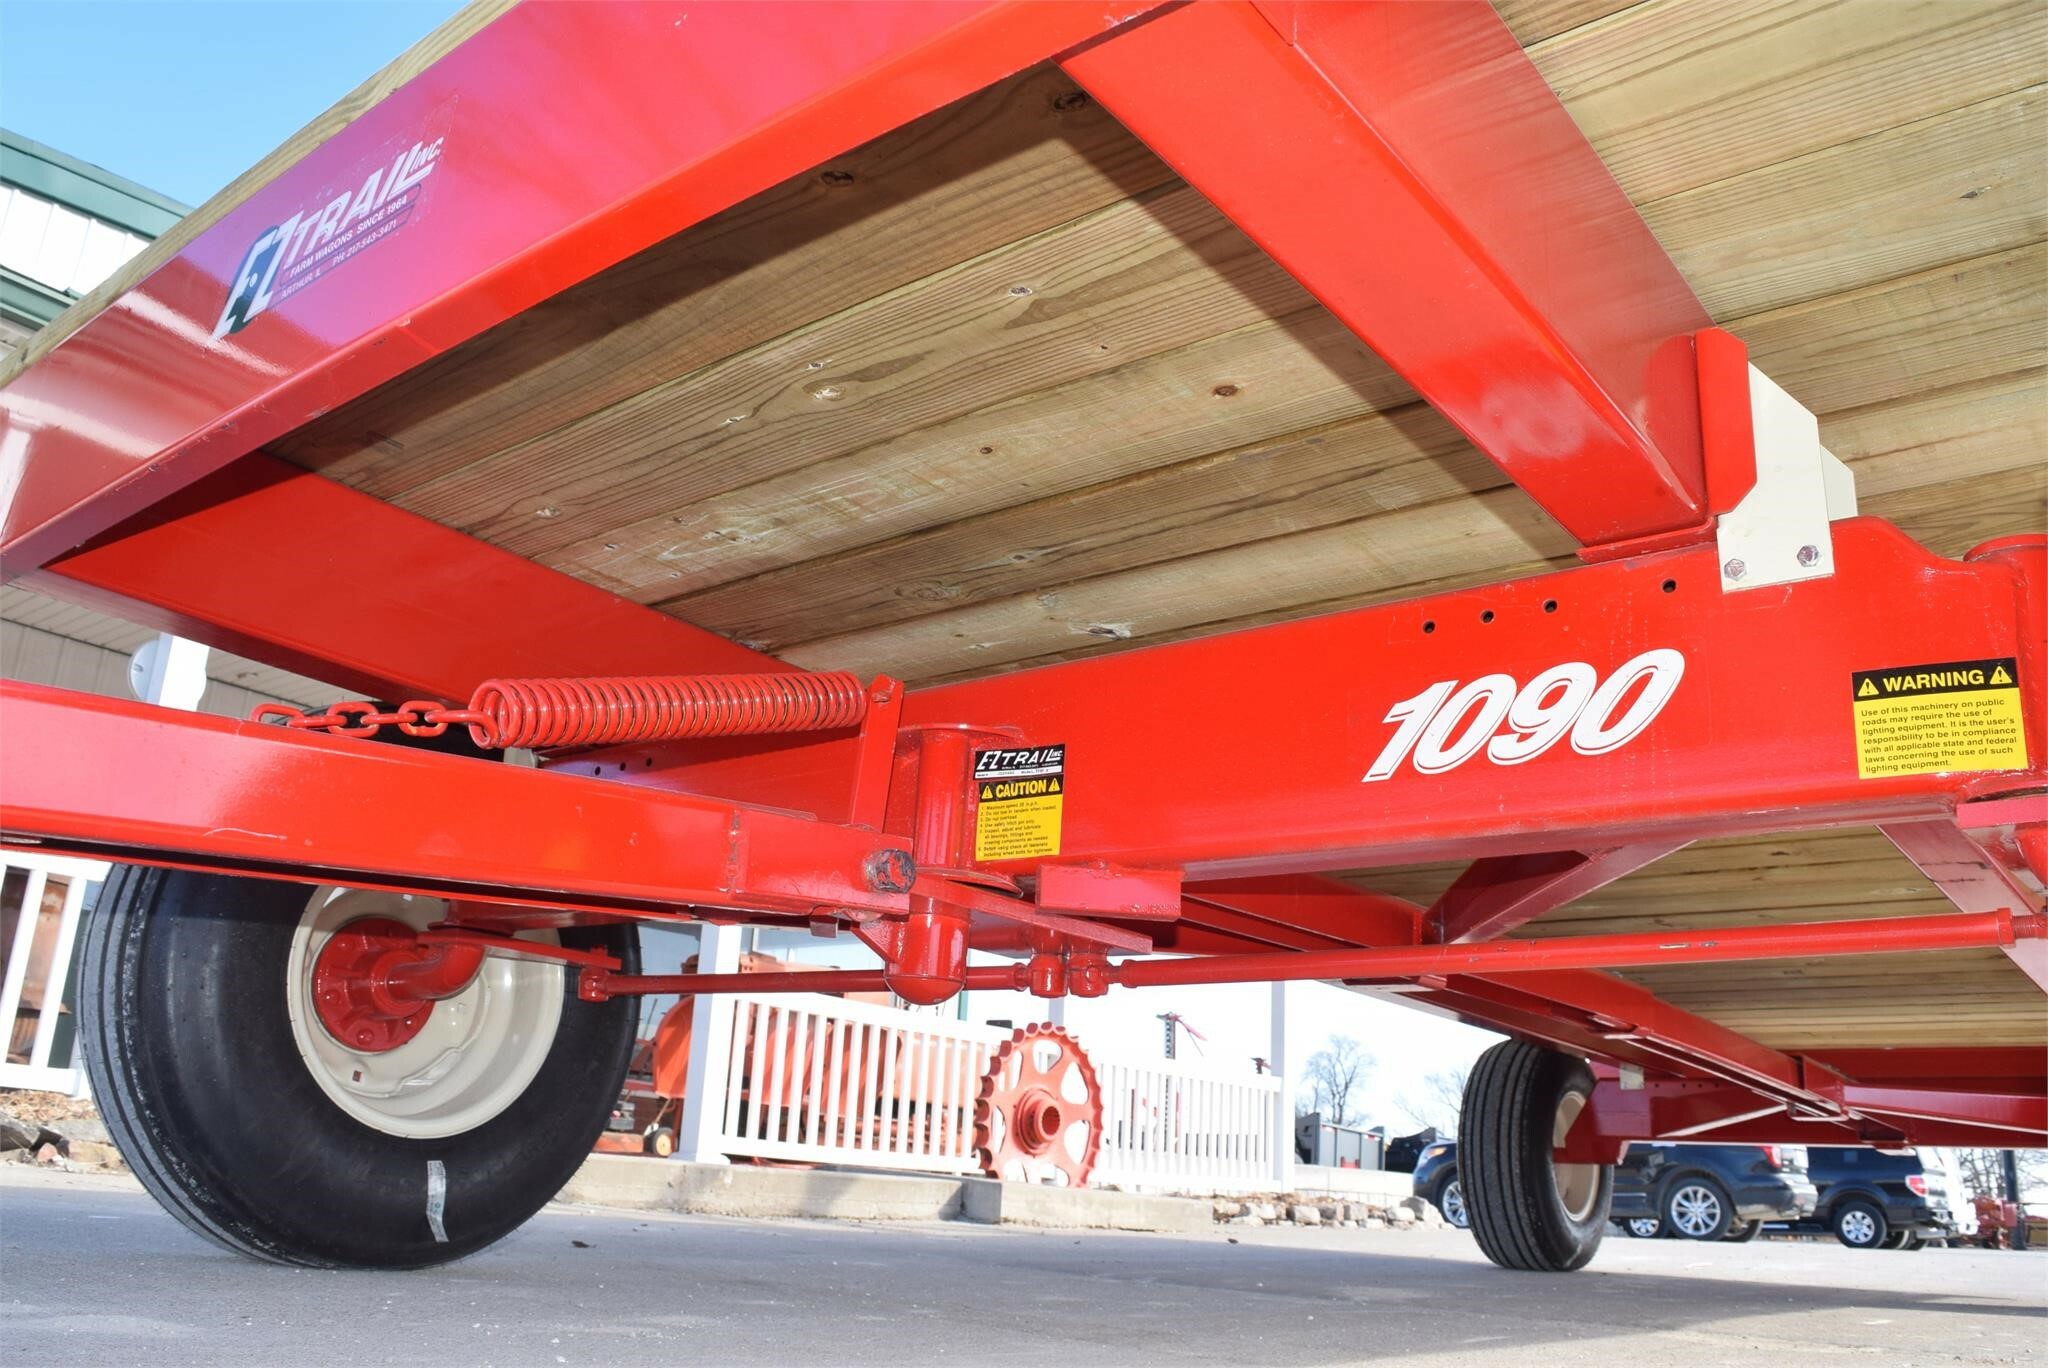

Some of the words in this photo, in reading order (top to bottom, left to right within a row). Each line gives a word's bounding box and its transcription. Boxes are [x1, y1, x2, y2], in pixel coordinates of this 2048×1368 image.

[289, 255, 314, 278] FARM
[315, 230, 353, 261] WAGONS
[356, 208, 386, 235] SINCE
[386, 194, 408, 214] 1964
[1883, 669, 1985, 692] WARNING
[1360, 648, 1686, 783] 1090
[1861, 709, 1878, 717] Use
[1891, 706, 1909, 714] this
[1911, 703, 1958, 712] machinery
[1975, 698, 2005, 709] public
[1862, 718, 1887, 726] roads
[1889, 716, 1909, 724] may
[1911, 713, 1943, 722] require
[1946, 710, 1961, 718] the
[1963, 710, 1980, 718] use
[1983, 708, 1992, 716] of
[1863, 726, 1895, 736] lighting
[1897, 722, 1948, 732] equipment.
[1986, 717, 2015, 725] user's
[1864, 733, 1923, 744] responsibility
[1962, 727, 2017, 736] compliance
[1864, 745, 1881, 754] with
[1883, 744, 1894, 752] all
[1896, 740, 1941, 752] applicable
[1943, 739, 1964, 747] state
[1967, 737, 1984, 746] and
[1986, 736, 2017, 745] federal
[1865, 755, 1885, 763] laws
[1887, 750, 1939, 761] concerning
[1941, 749, 1956, 757] the
[1978, 747, 1988, 755] of
[1990, 746, 2014, 754] such
[1866, 763, 1898, 774] lighting
[1901, 759, 1951, 770] equipment.
[995, 779, 1047, 798] CAUTION
